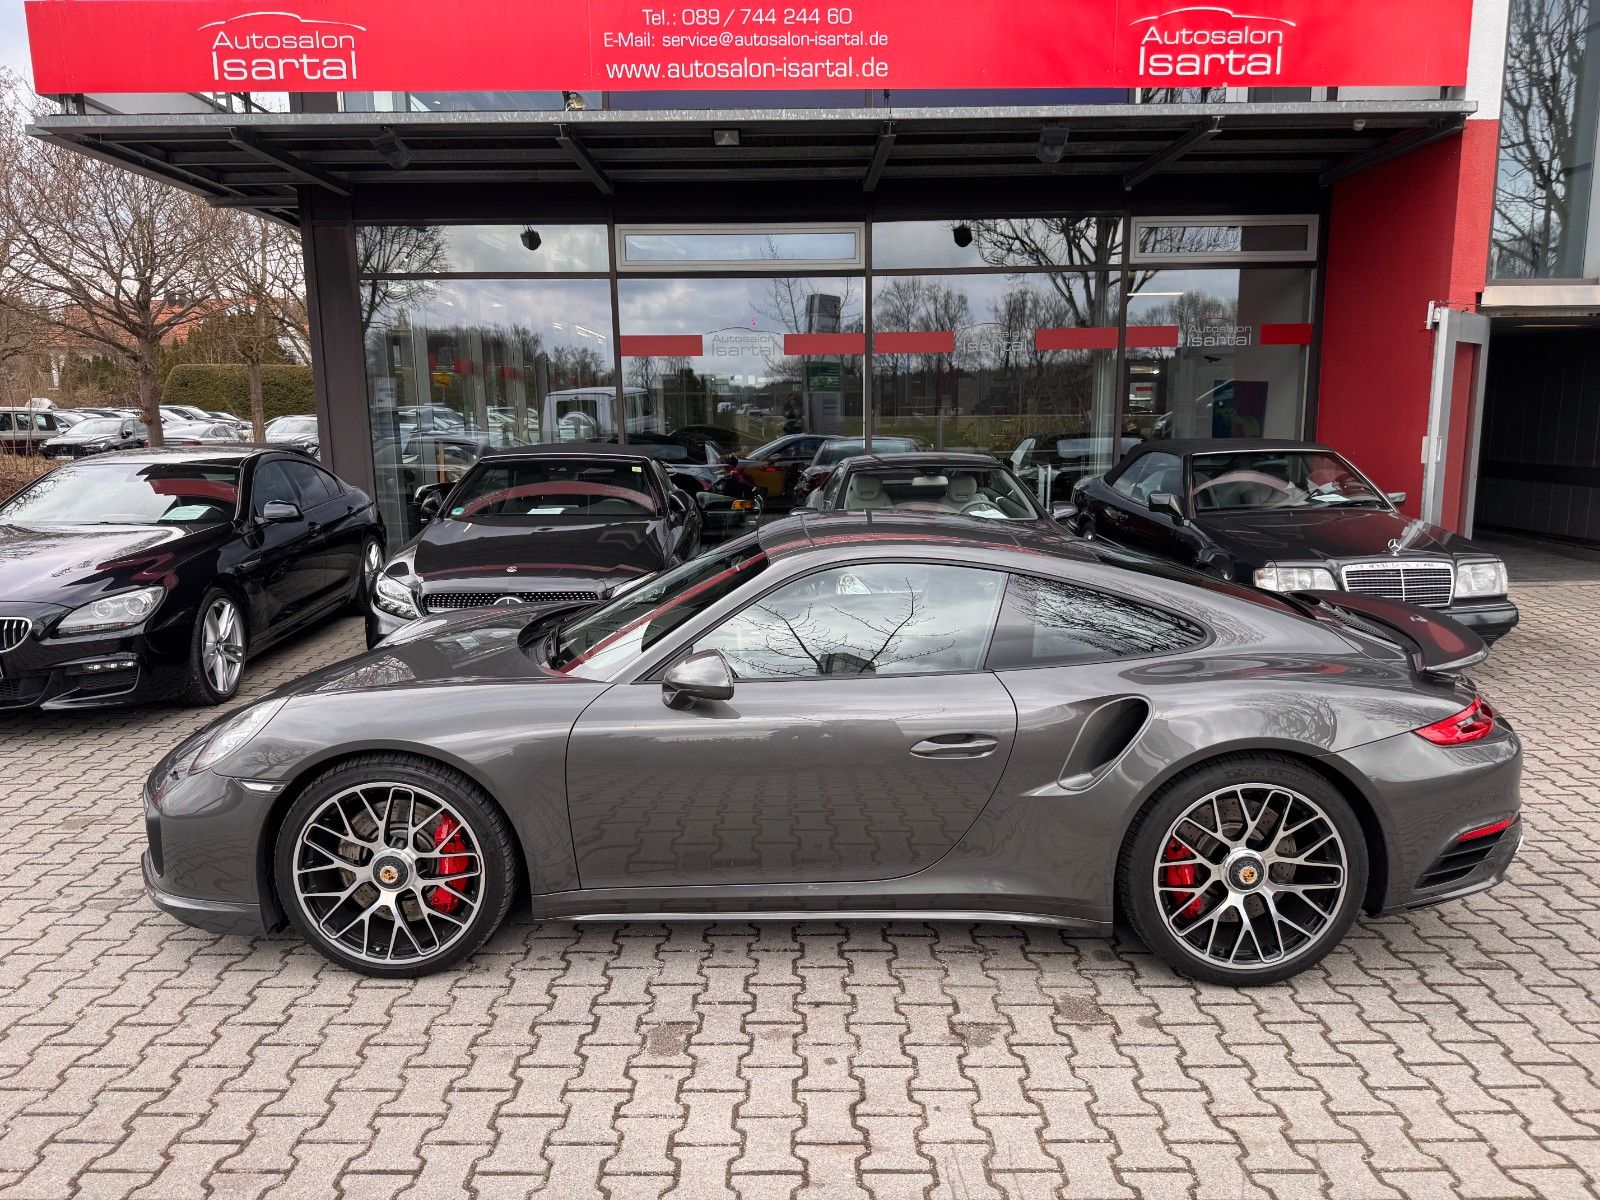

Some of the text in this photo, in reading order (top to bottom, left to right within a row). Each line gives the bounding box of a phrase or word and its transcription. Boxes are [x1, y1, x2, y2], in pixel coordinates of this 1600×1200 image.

[641, 9, 677, 26] Tel.:
[681, 8, 720, 26] 089
[740, 8, 777, 25] 744
[783, 8, 821, 25] 244
[827, 7, 853, 25] 60
[211, 31, 355, 50] Autosalon
[603, 31, 889, 48] E-Mail: service@autosalon-isartal.de
[1140, 25, 1284, 45] Autosalon
[211, 51, 357, 81] Isartal
[605, 56, 889, 79] www.autosalon-isartal.de
[1138, 45, 1283, 76] Isartal
[711, 342, 776, 357] Isartal
[1186, 333, 1252, 347] Isartal
